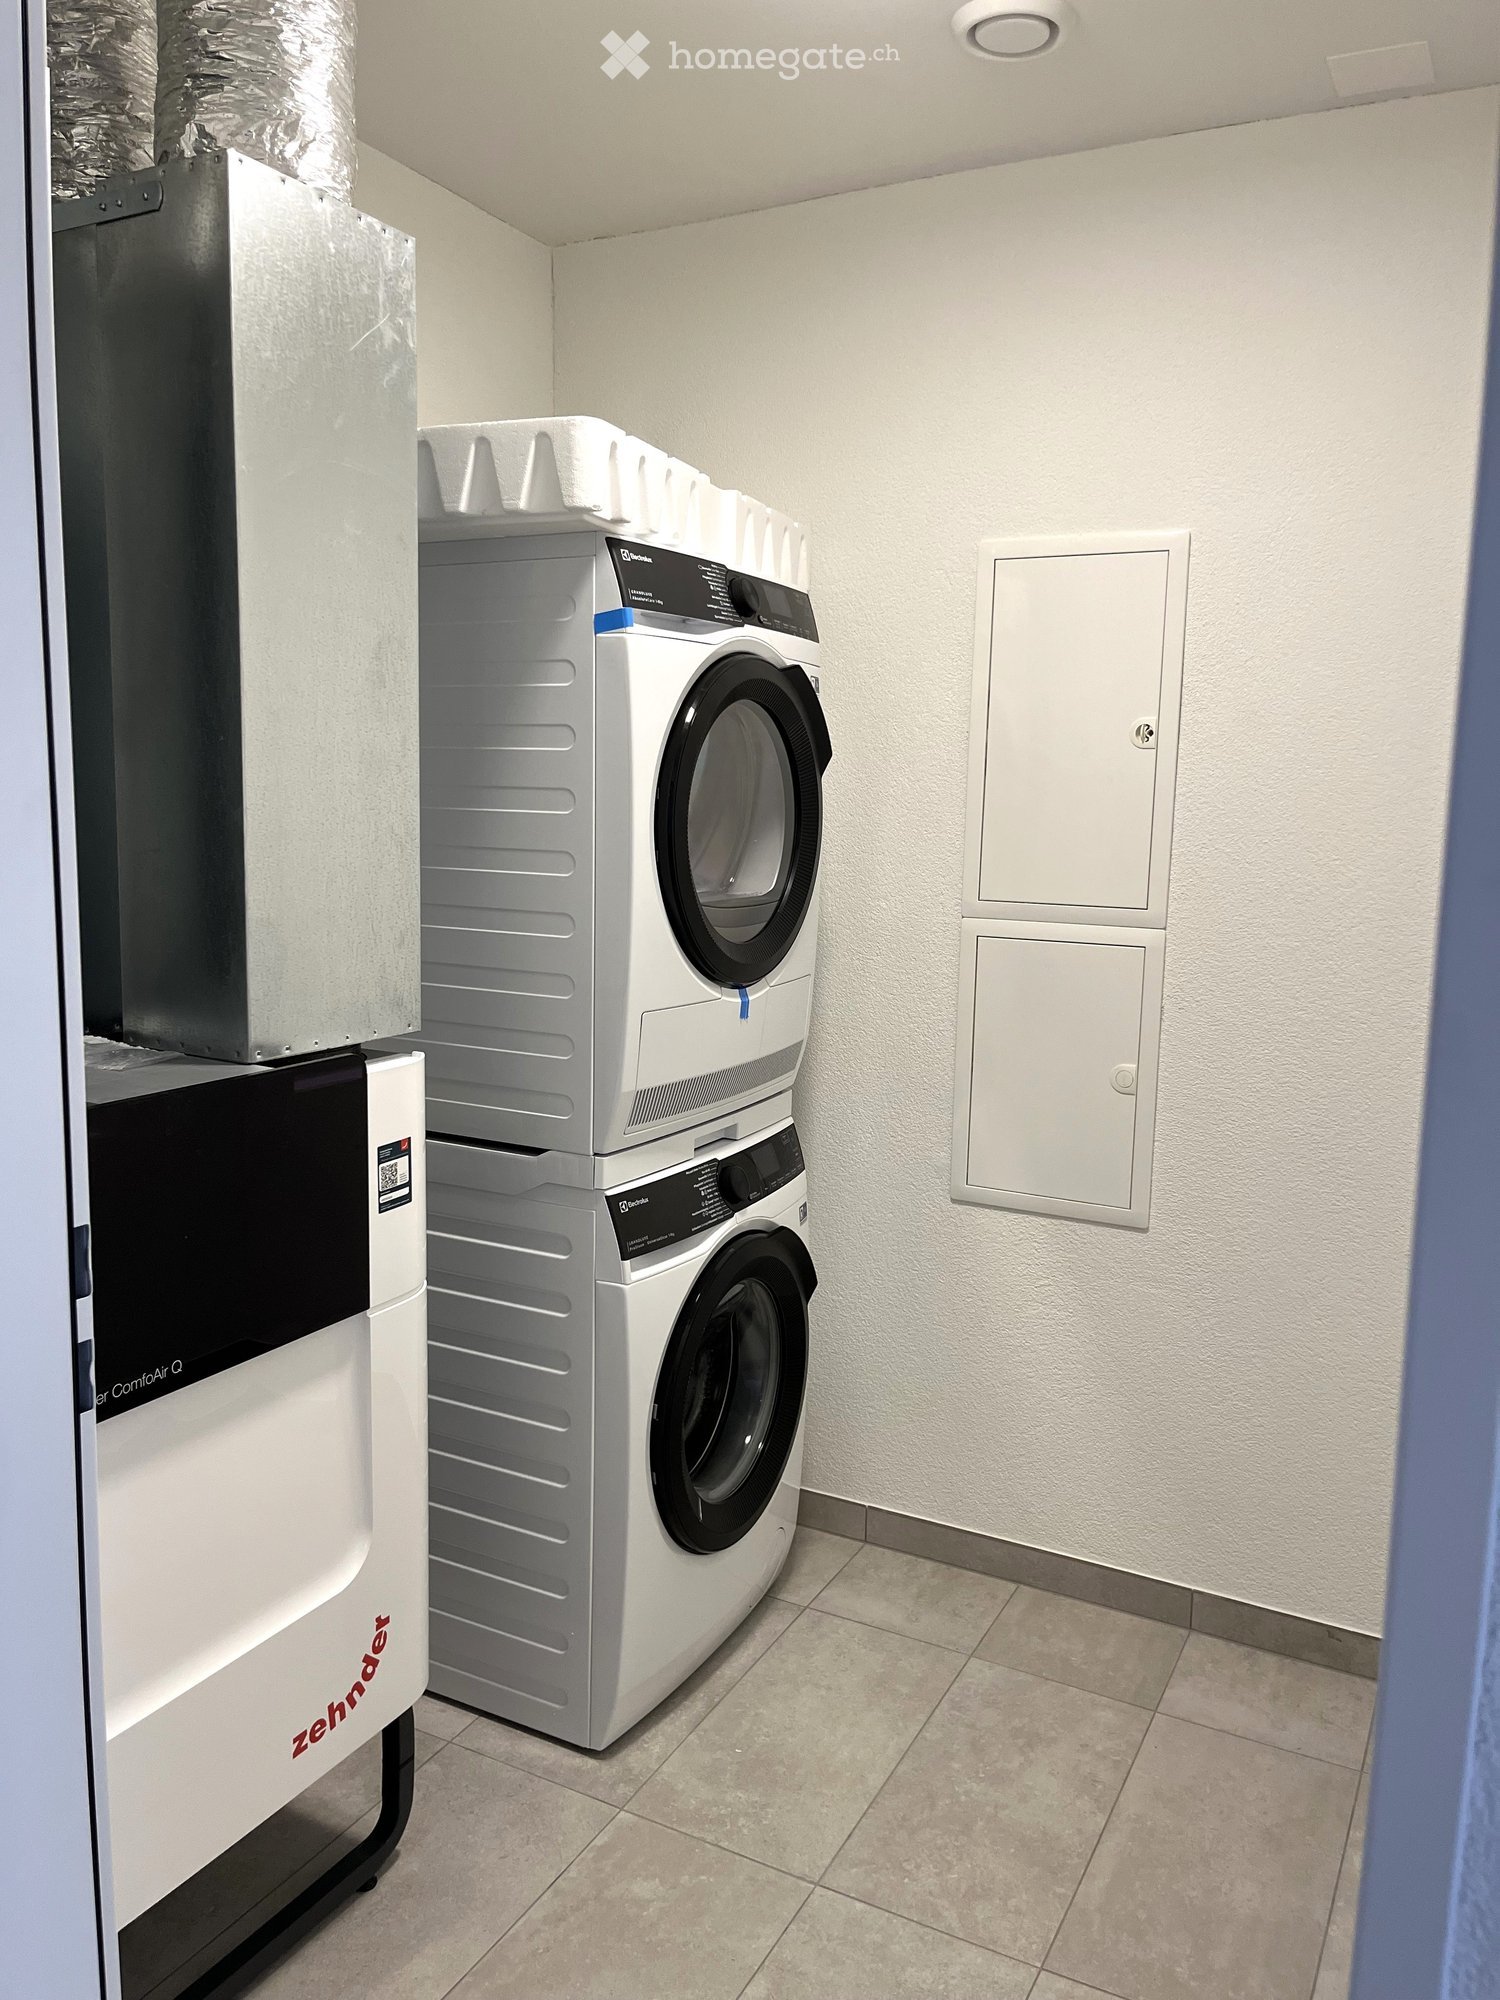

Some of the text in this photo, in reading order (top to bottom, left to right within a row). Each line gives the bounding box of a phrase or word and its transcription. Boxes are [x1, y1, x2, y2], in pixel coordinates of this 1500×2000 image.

[628, 1197, 649, 1208] Electrolux
[112, 1366, 169, 1398] ComfoAir
[171, 1360, 183, 1374] Q
[292, 1614, 391, 1760] zehnder
